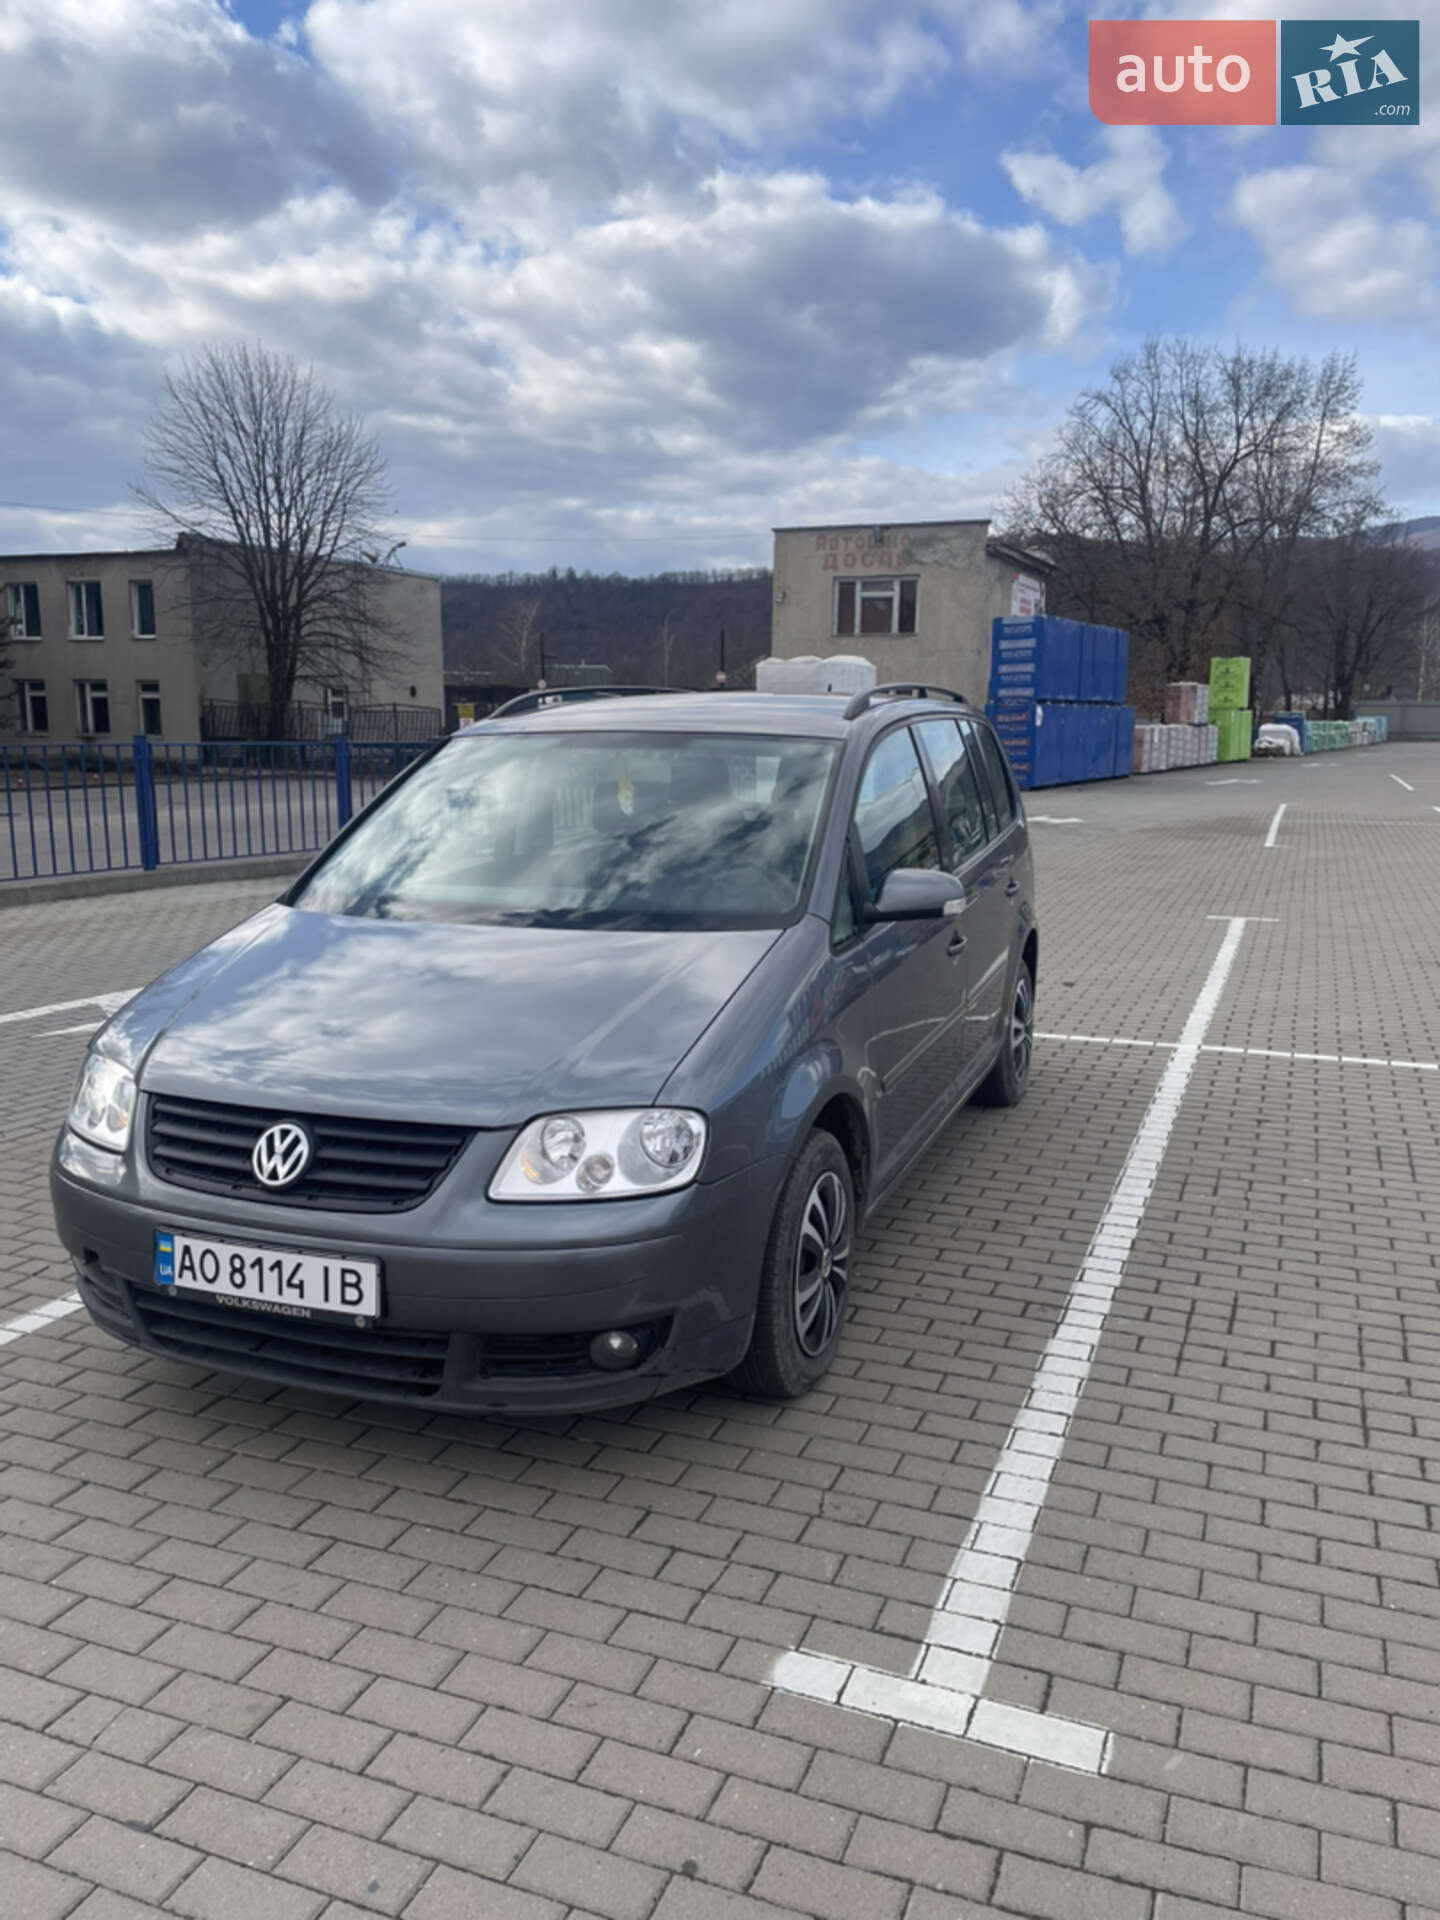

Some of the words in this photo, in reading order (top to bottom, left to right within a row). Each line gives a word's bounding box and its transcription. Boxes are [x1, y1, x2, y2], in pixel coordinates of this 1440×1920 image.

[159, 1264, 173, 1276] UA
[178, 1244, 219, 1284] AO
[229, 1253, 305, 1299] 8114
[323, 1265, 364, 1307] IB
[216, 1294, 311, 1319] VOLKSWAGEN
